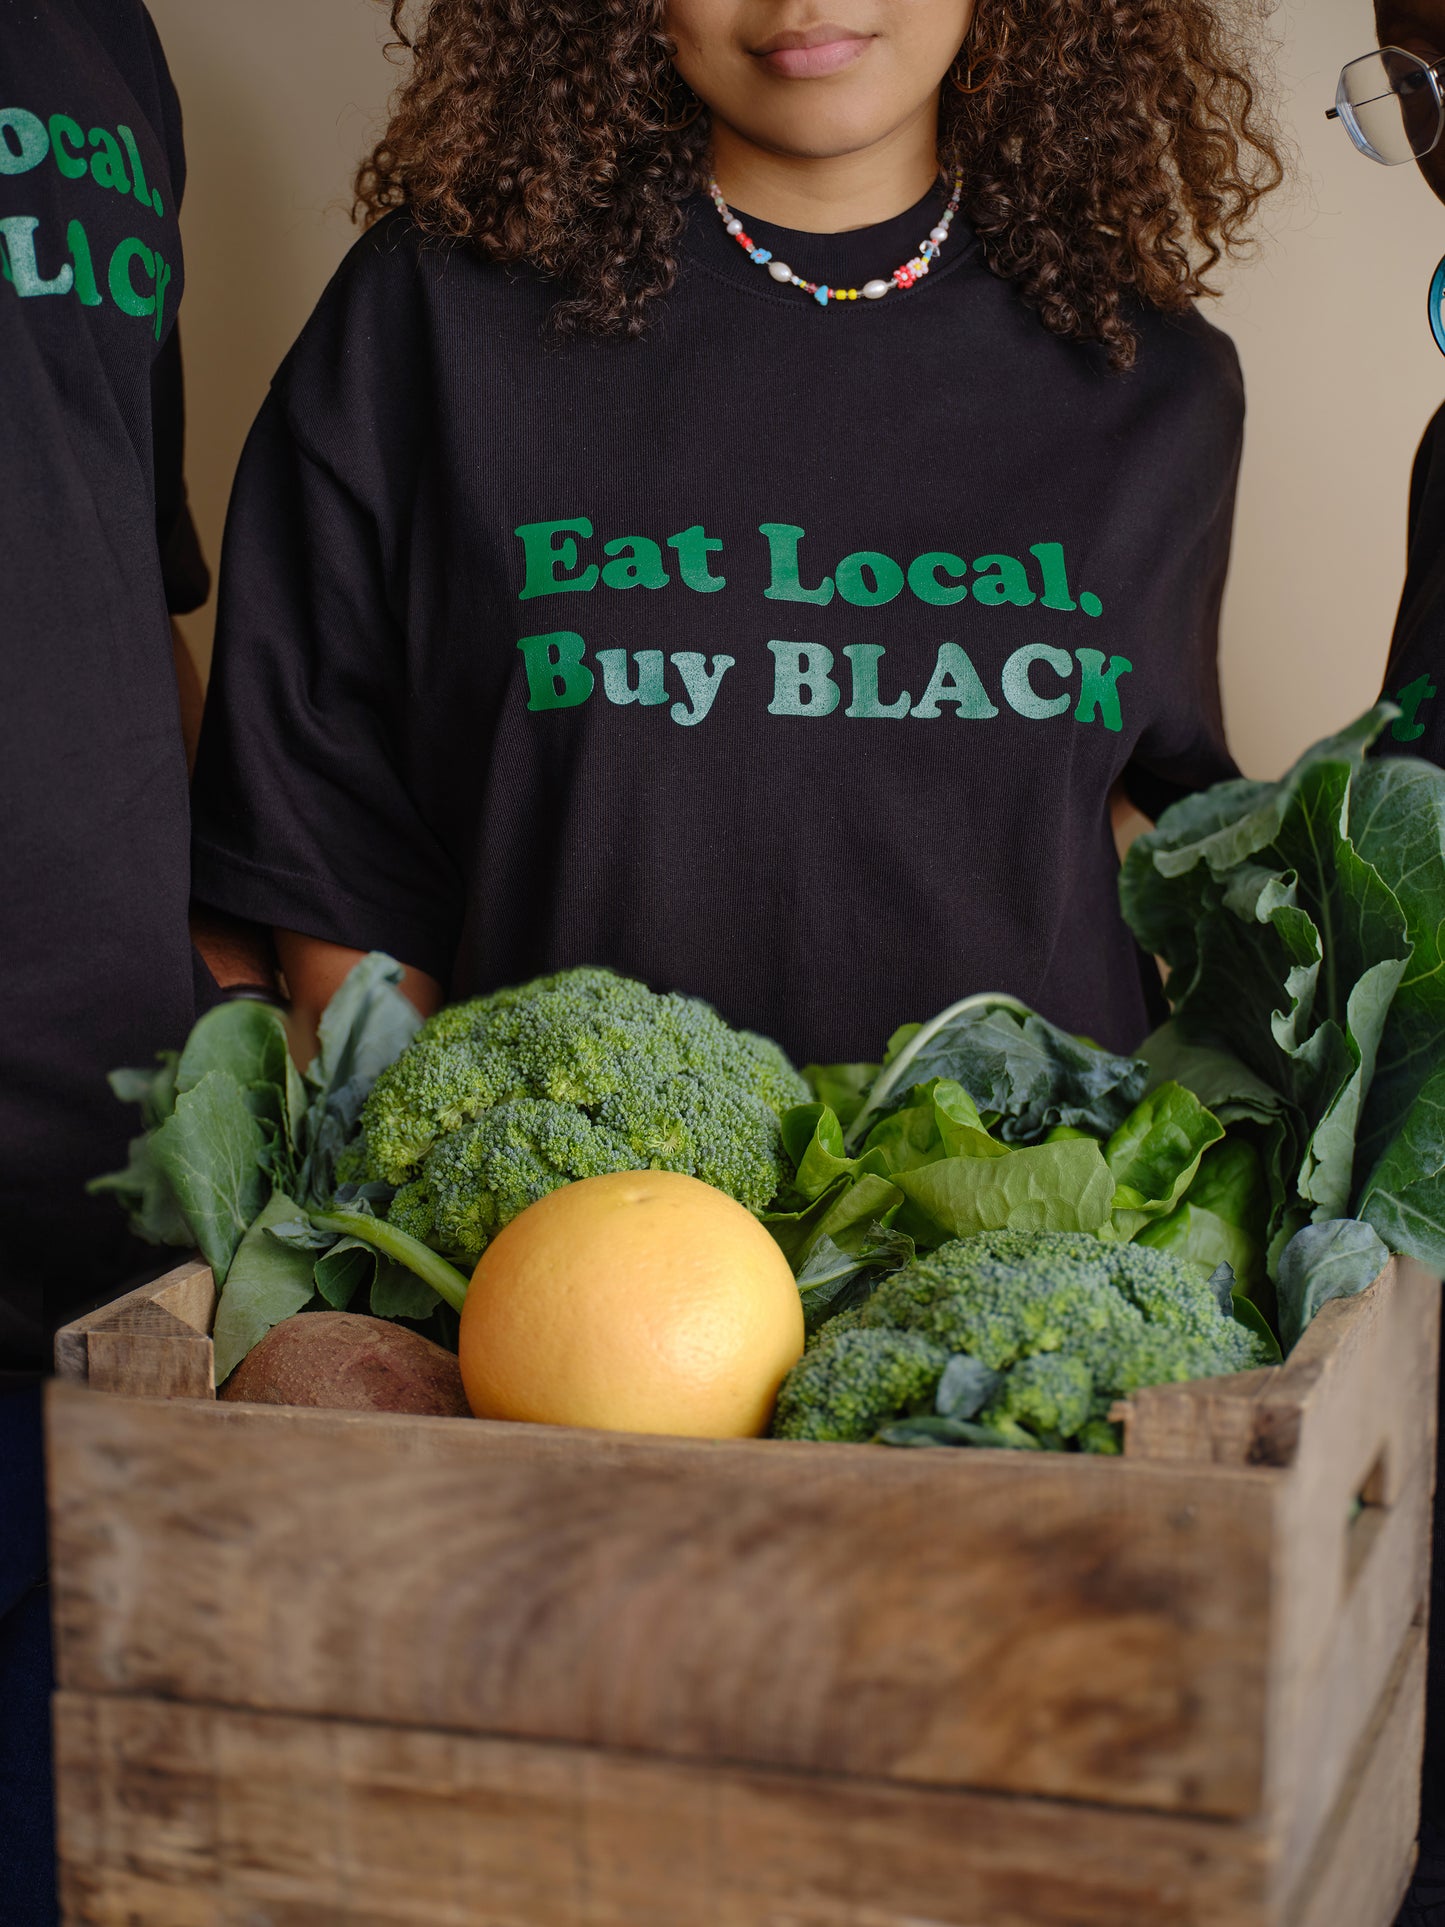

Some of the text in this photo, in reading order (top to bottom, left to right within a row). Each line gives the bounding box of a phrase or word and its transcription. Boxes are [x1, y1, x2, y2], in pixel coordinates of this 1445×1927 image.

[514, 516, 1103, 618] Eat Local.
[516, 630, 1133, 732] Buy BLACK
